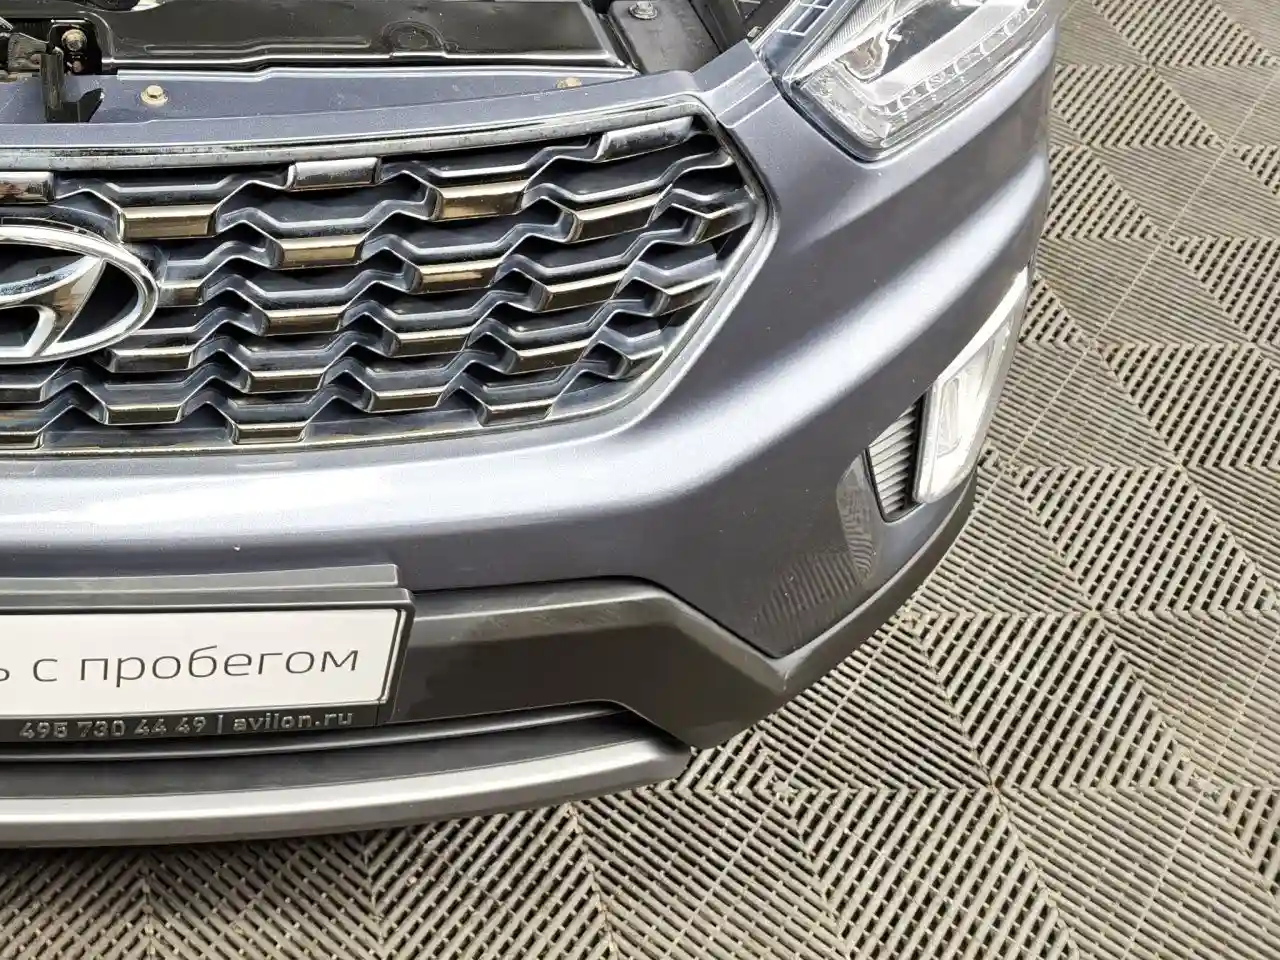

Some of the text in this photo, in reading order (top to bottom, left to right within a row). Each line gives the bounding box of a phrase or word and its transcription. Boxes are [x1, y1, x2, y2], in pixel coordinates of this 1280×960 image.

[32, 657, 59, 683] с
[79, 644, 359, 689] пробегом
[19, 720, 69, 740] 495
[77, 719, 126, 739] 730
[134, 717, 168, 737] 44
[175, 715, 208, 734] 49
[233, 710, 354, 733] avilon.ru
